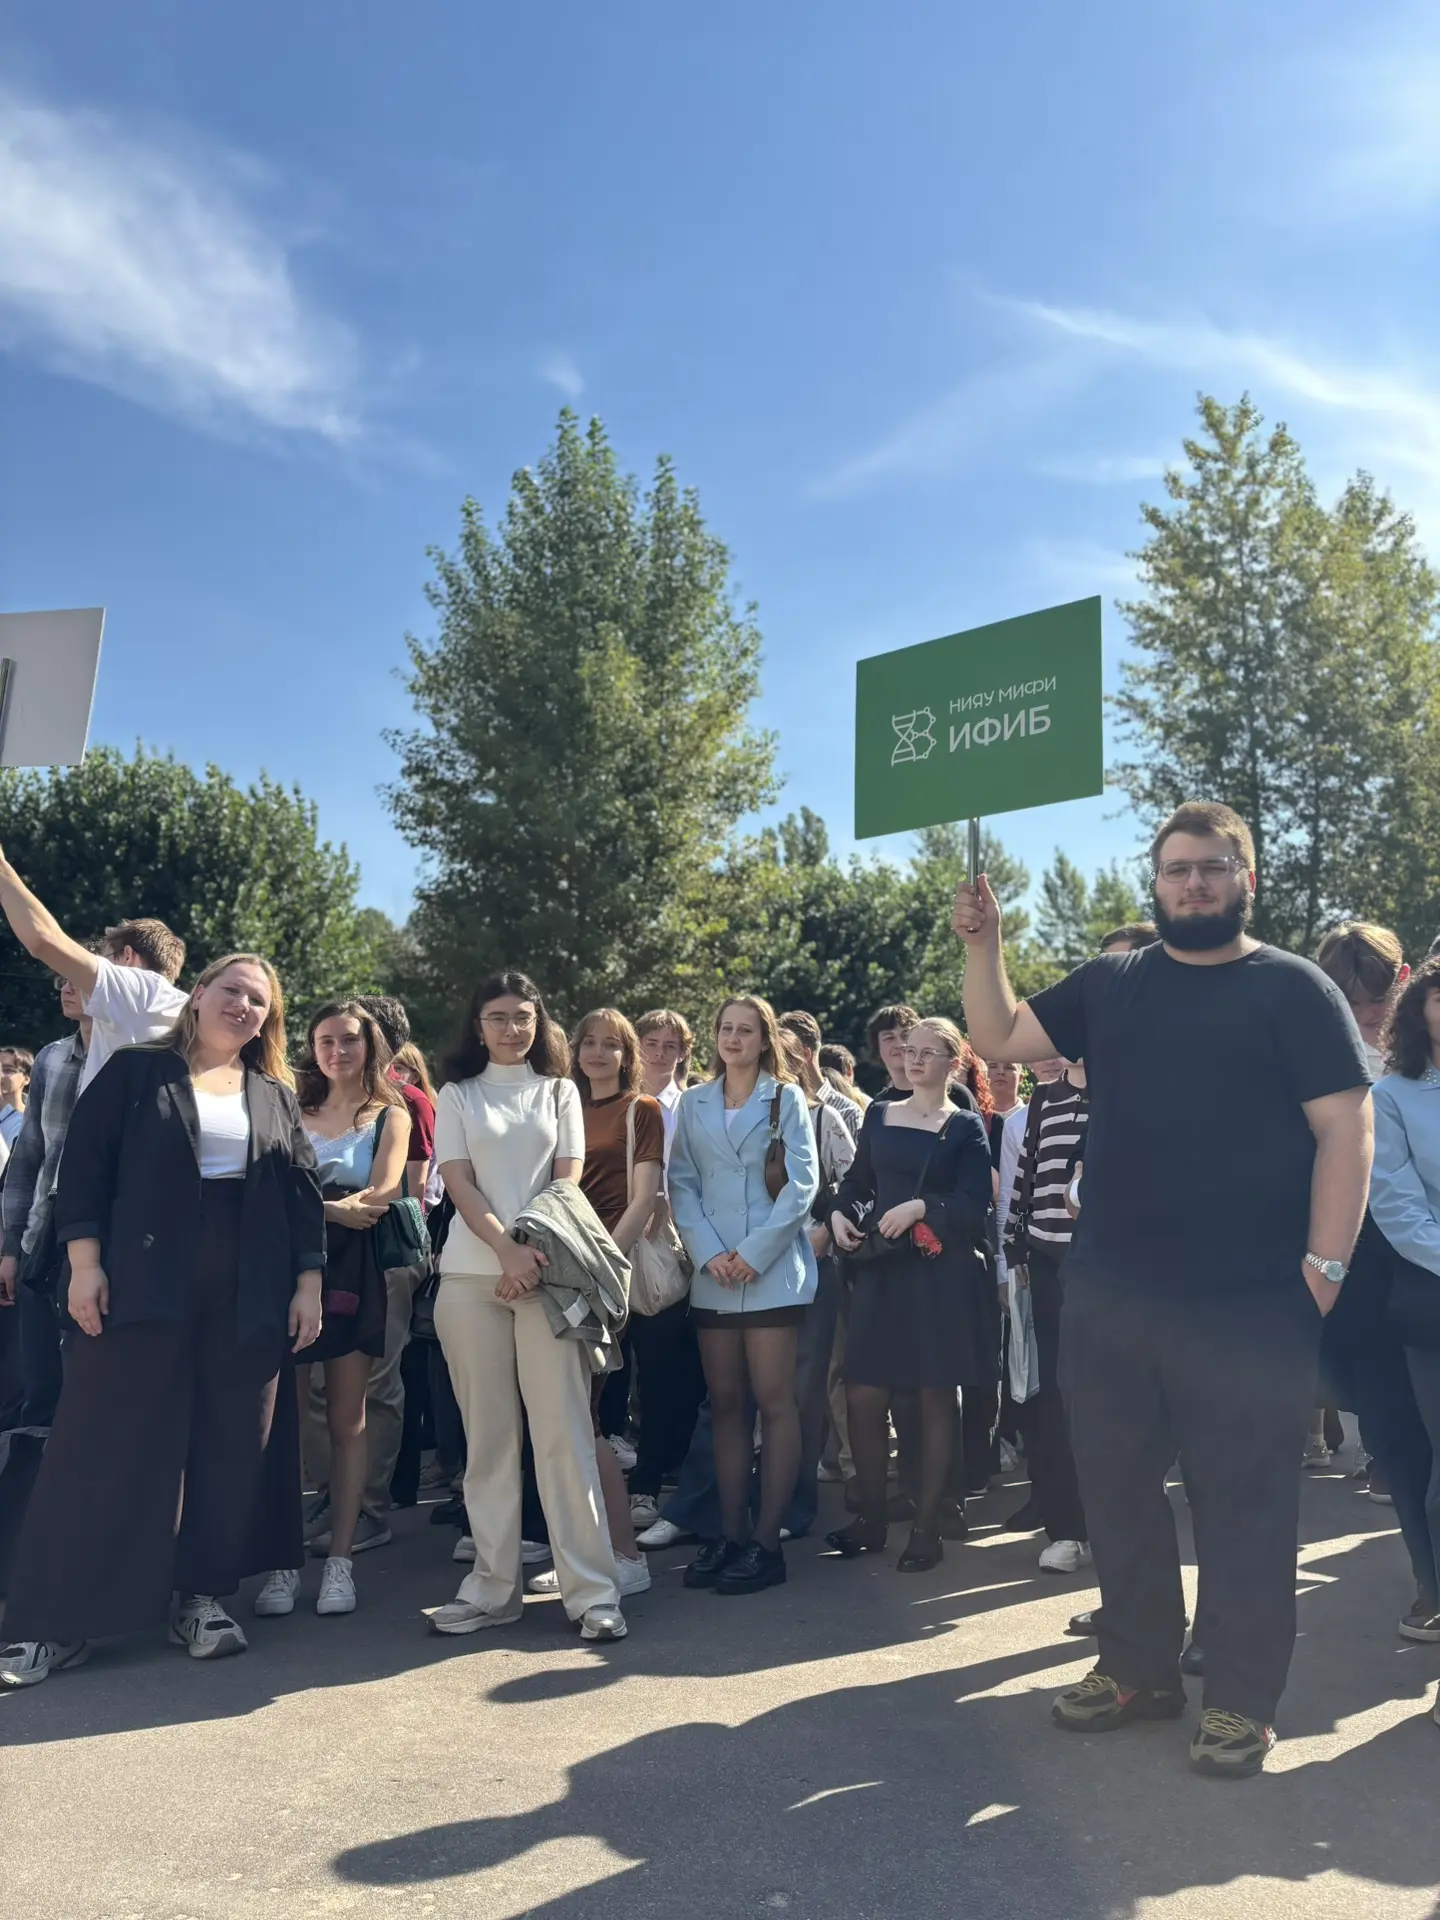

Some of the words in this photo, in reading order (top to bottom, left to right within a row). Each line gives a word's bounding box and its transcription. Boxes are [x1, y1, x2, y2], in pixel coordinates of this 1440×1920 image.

[949, 690, 995, 714] НИЯУ
[998, 676, 1057, 702] МИФИ
[949, 704, 1052, 753] ИФИБ
